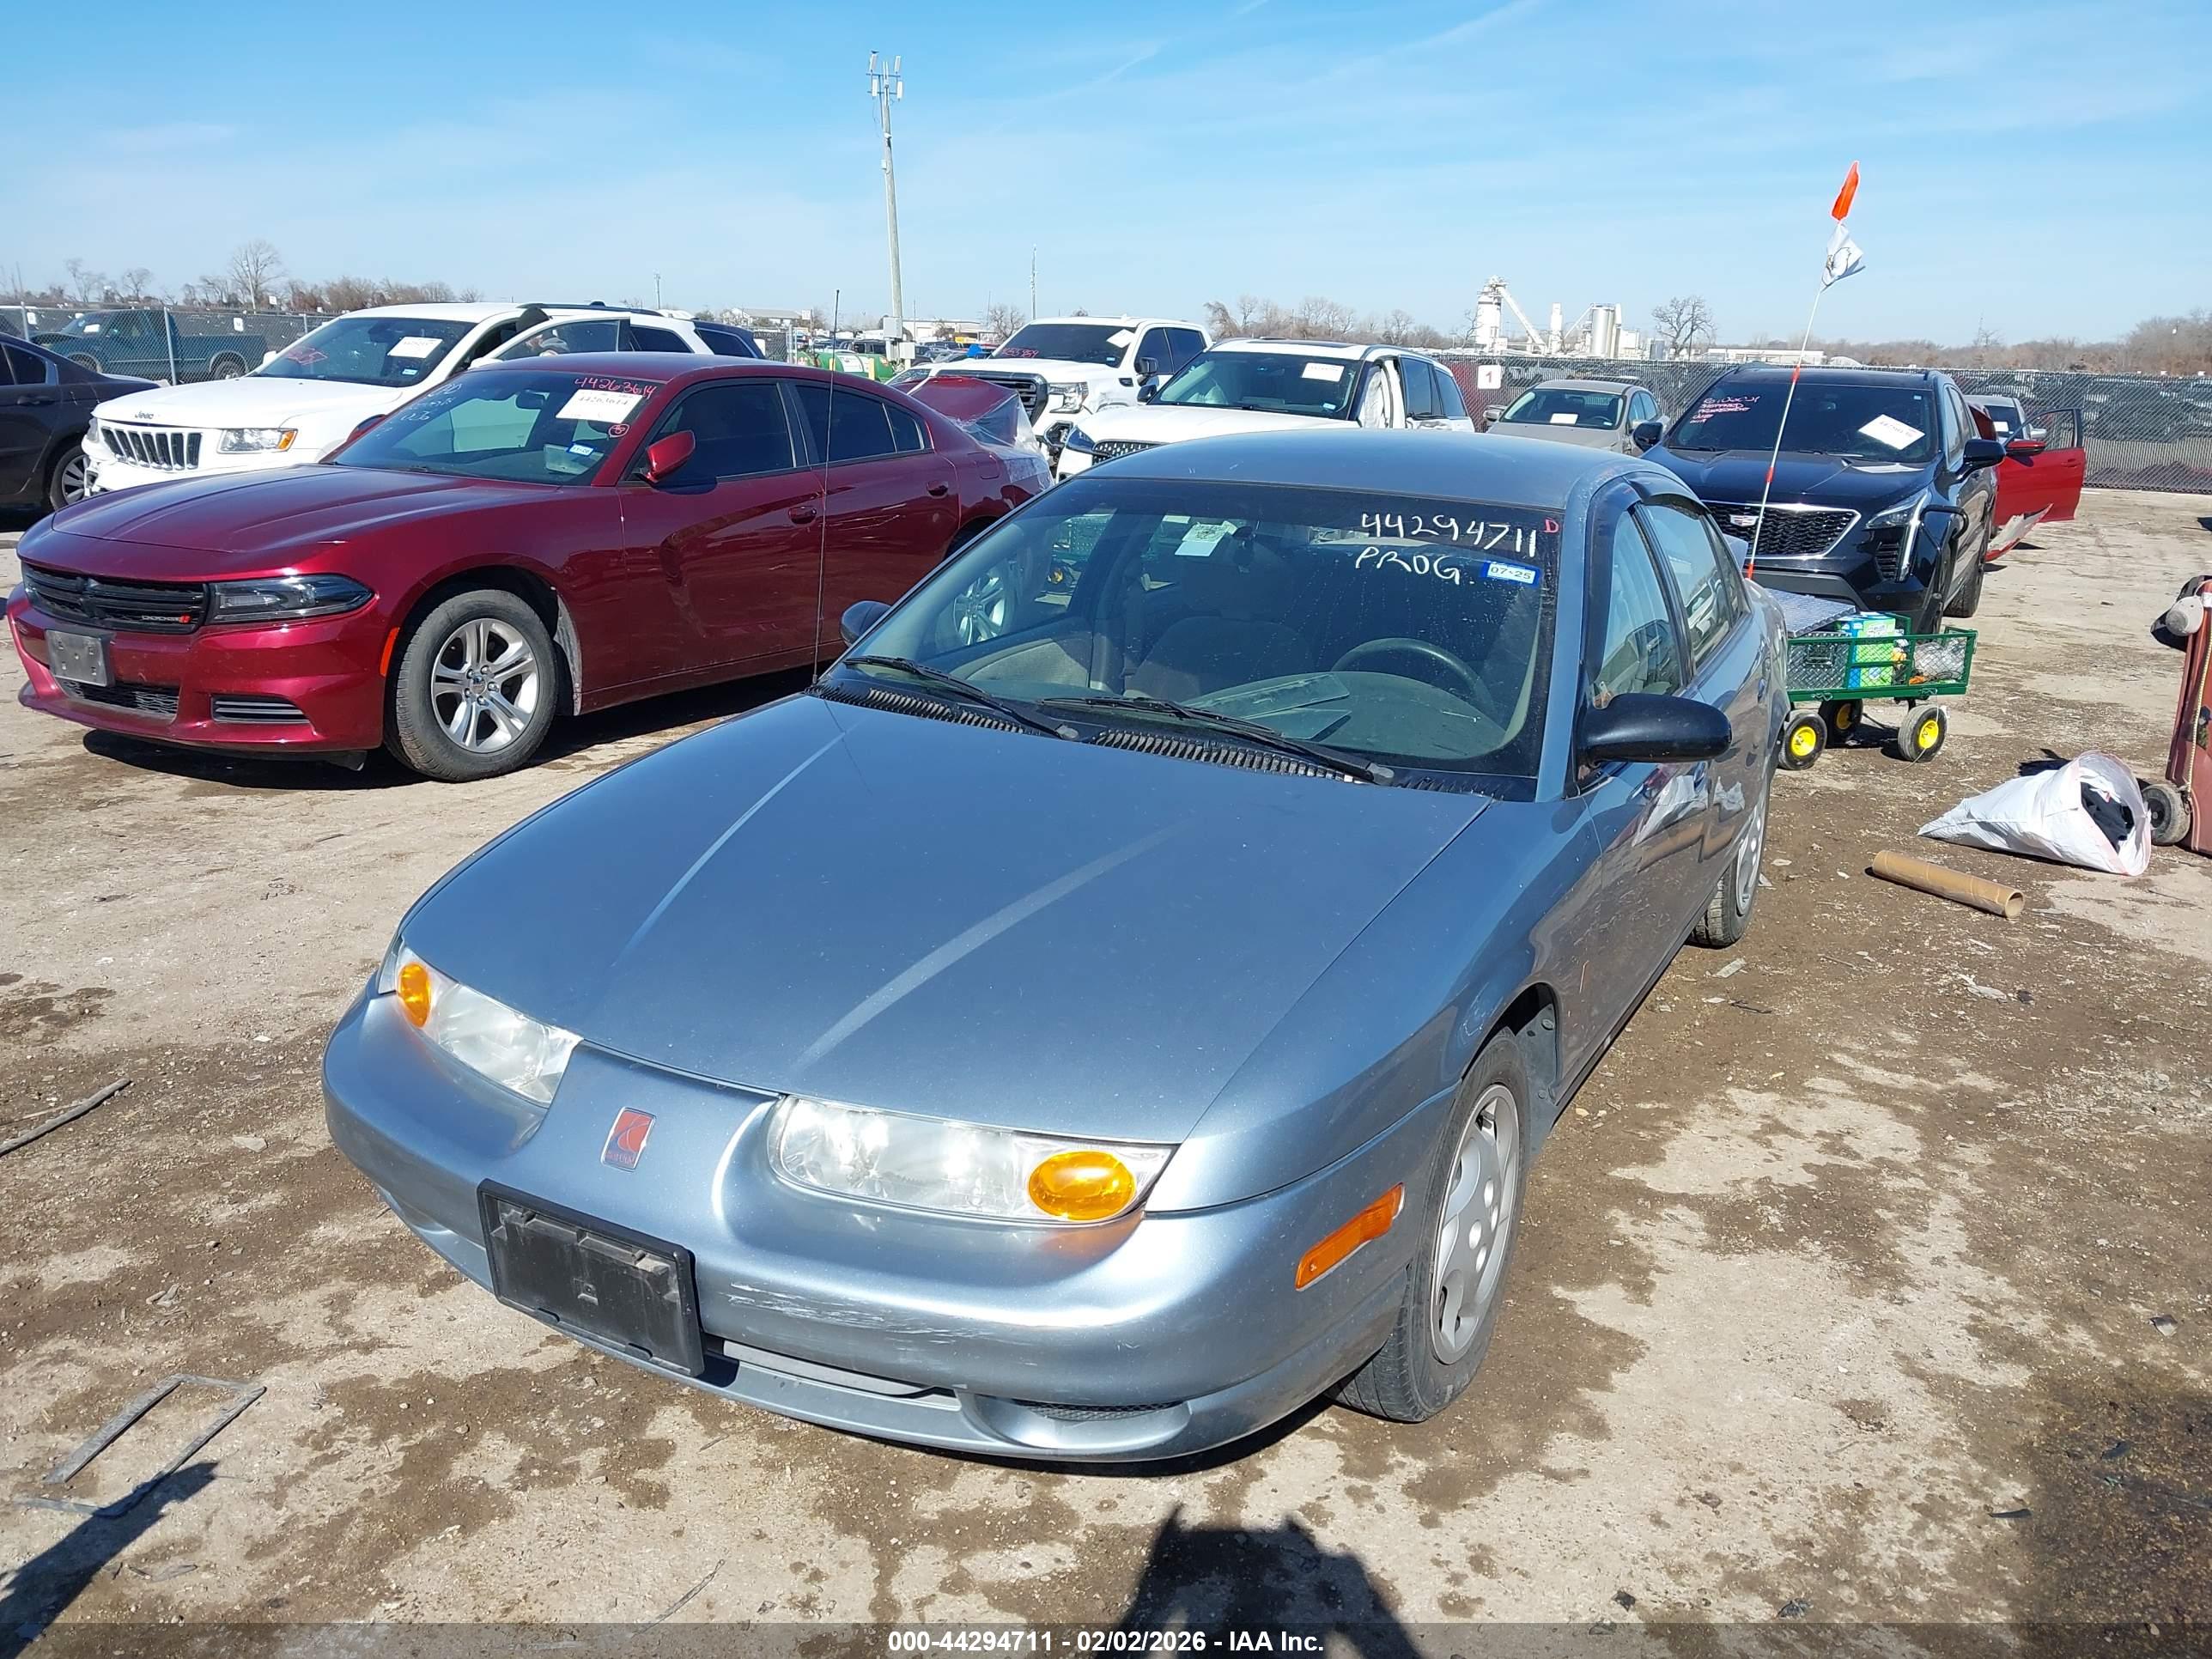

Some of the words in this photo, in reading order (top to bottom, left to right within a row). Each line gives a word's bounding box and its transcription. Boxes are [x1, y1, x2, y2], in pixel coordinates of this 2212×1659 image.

[574, 377, 657, 400] 44263614
[1486, 370, 1492, 384] 1
[1361, 514, 1537, 558] 44294711
